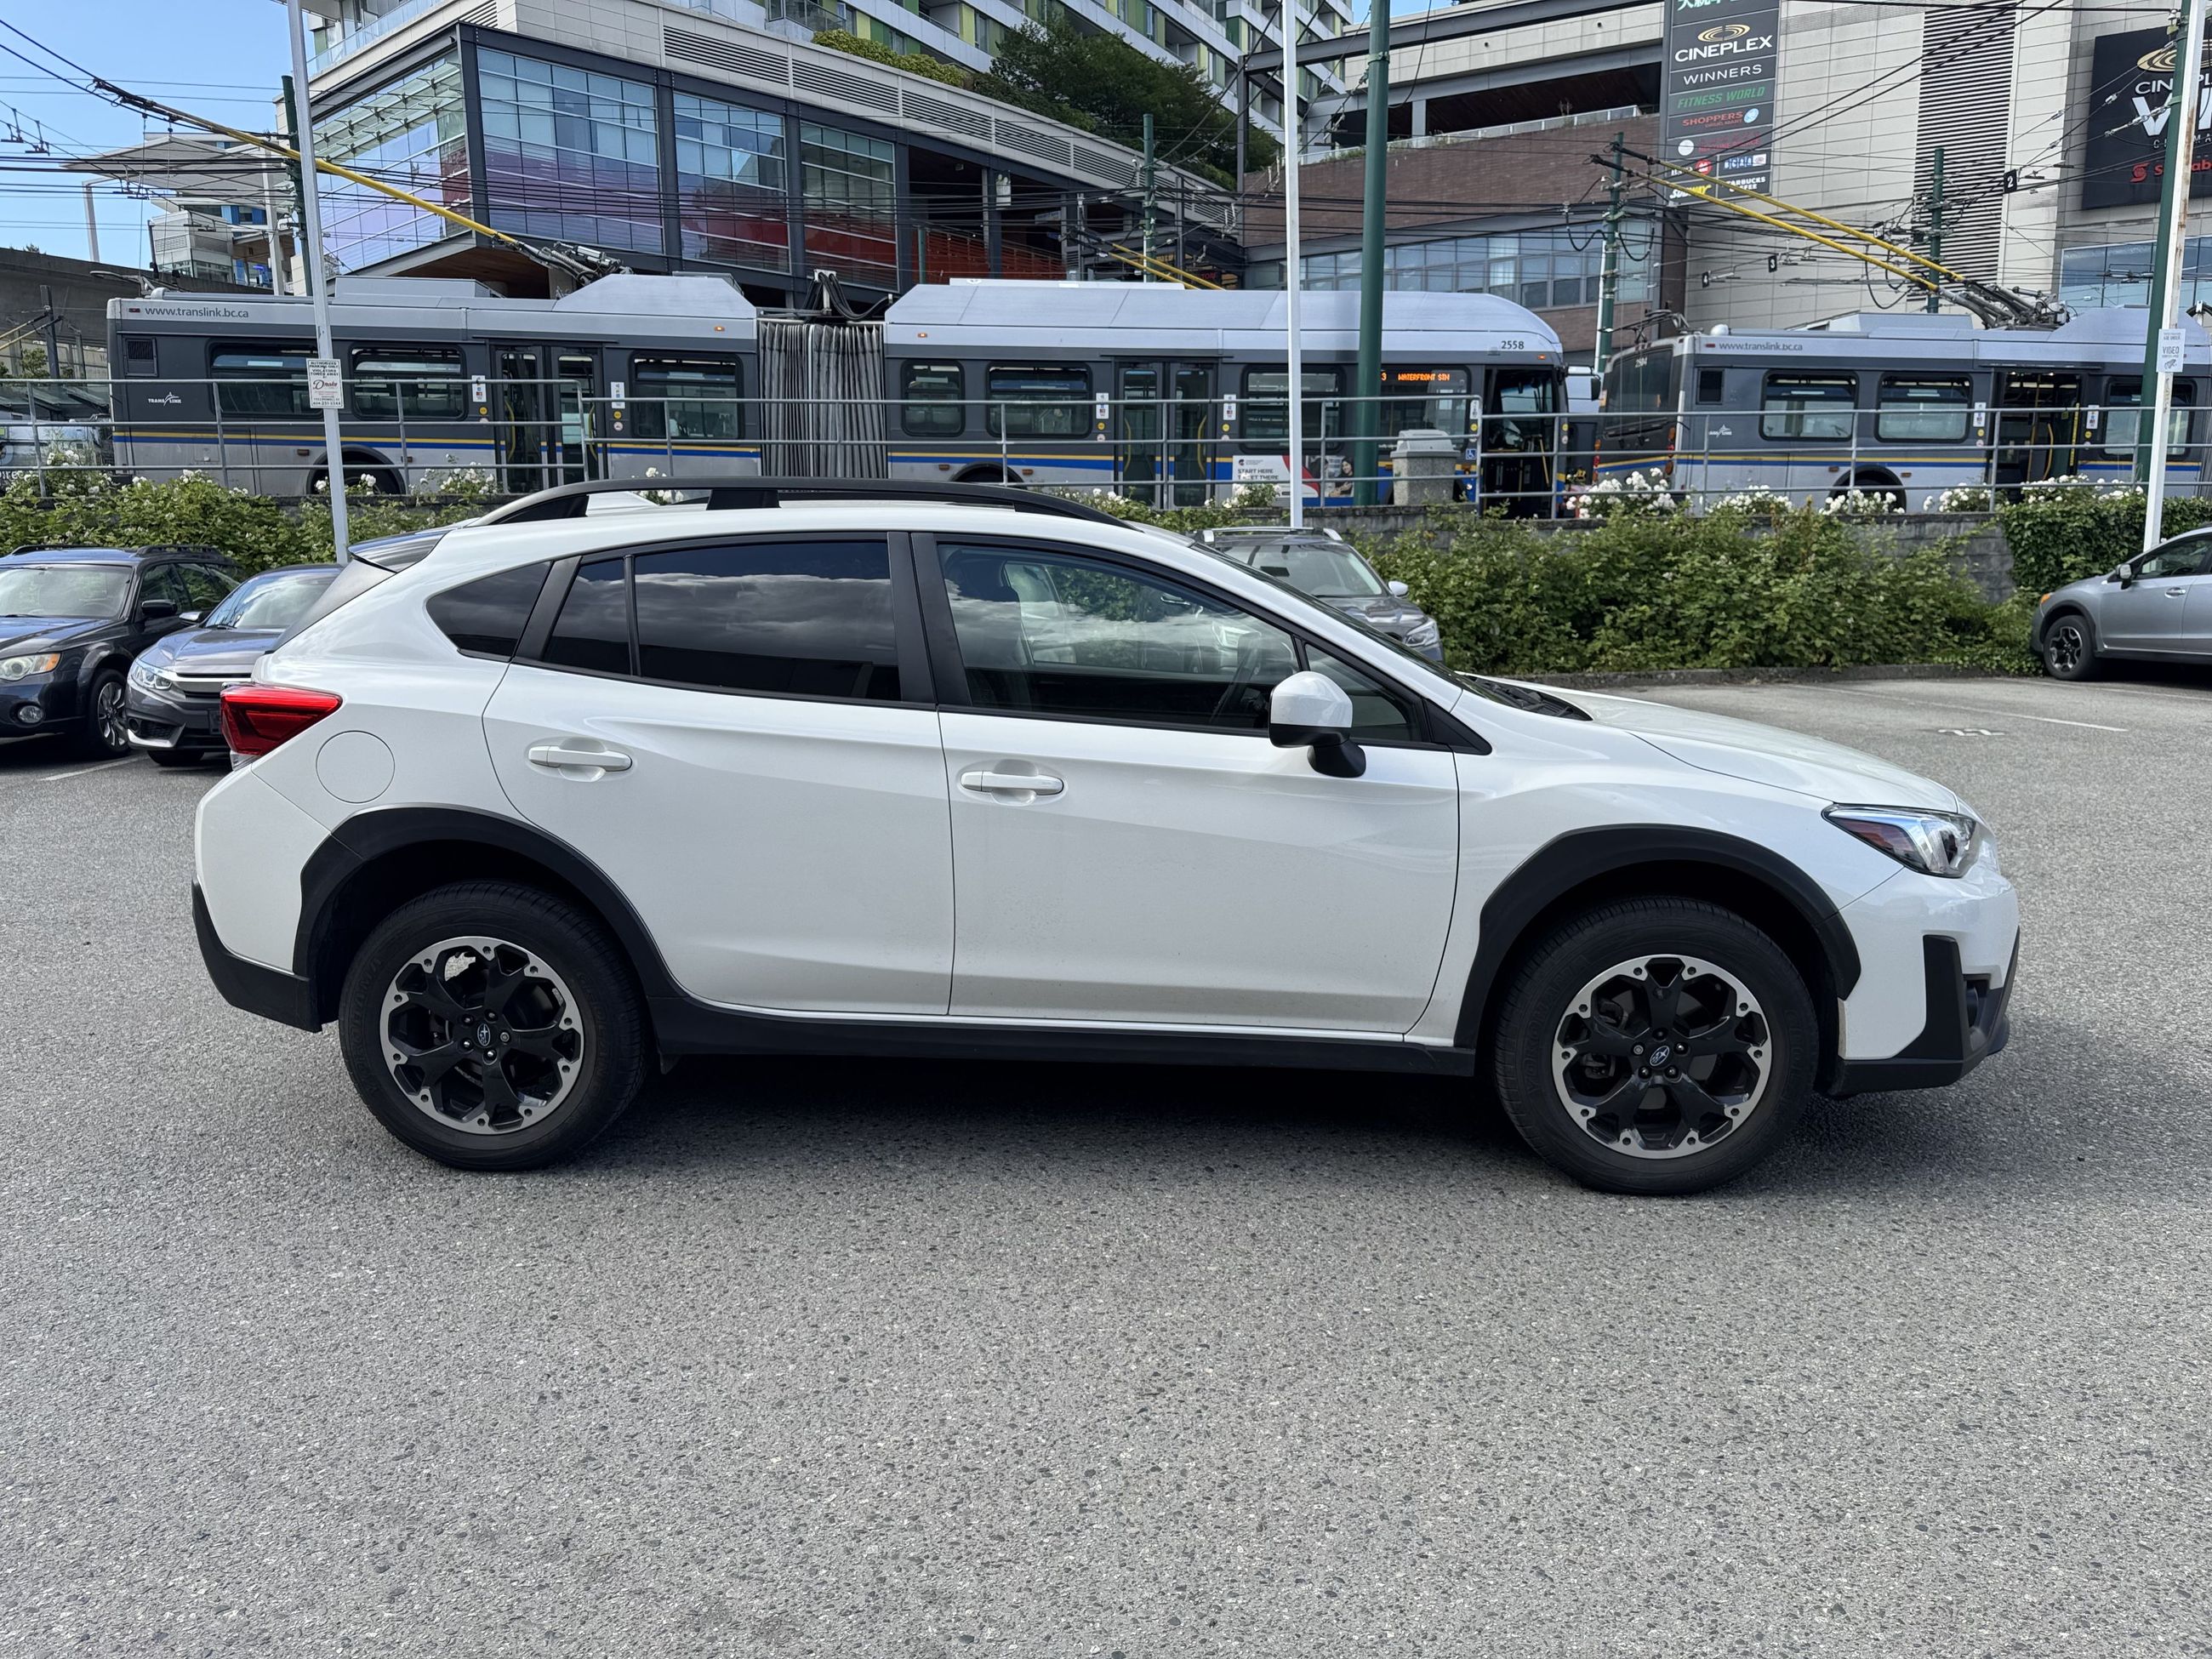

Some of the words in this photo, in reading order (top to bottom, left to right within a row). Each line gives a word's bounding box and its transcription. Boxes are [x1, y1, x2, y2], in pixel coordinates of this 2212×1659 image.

[1674, 35, 1773, 63] CINEPLEX
[1683, 64, 1762, 85] WINNERS
[1678, 93, 1723, 109] FITNESS
[1726, 86, 1765, 101] WORLD
[1682, 111, 1743, 127] SHOPPERS
[2008, 175, 2013, 188] 2
[145, 307, 249, 318] www.translink.bc.ca
[1501, 340, 1525, 350] 2558
[1719, 342, 1803, 351] www.translink.bc.ca
[2163, 345, 2179, 354] VIDEO
